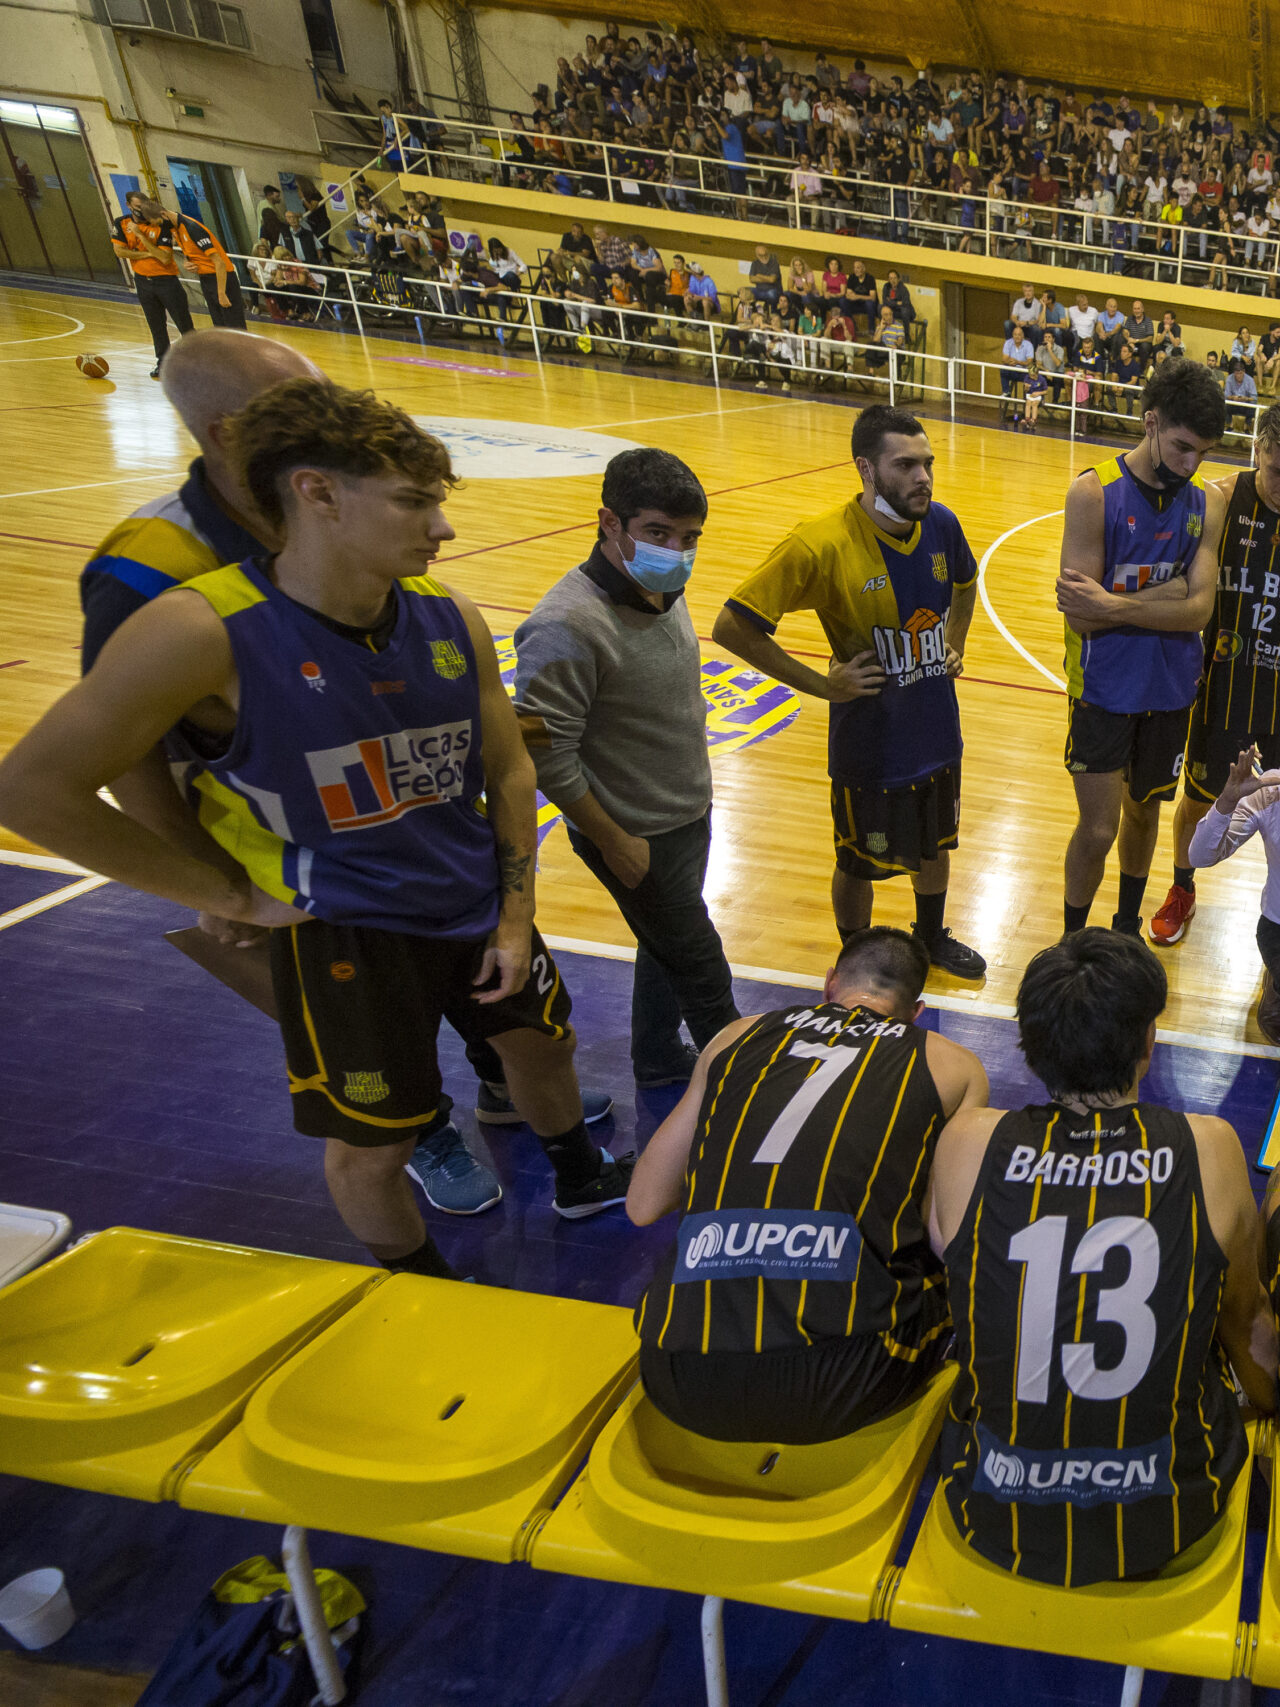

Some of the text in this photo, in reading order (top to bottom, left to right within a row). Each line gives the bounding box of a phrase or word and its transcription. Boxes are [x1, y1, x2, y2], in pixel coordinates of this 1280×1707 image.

[918, 606, 951, 665] BO
[1252, 602, 1276, 632] 12
[898, 664, 947, 687] SANTA ROS
[531, 954, 554, 994] 2
[751, 1039, 861, 1163] 7
[1005, 1144, 1174, 1187] BARROSO
[724, 1222, 850, 1259] UPCN
[770, 1259, 788, 1267] CIVIL
[1008, 1215, 1161, 1404] 13
[1027, 1454, 1158, 1488] UPCN
